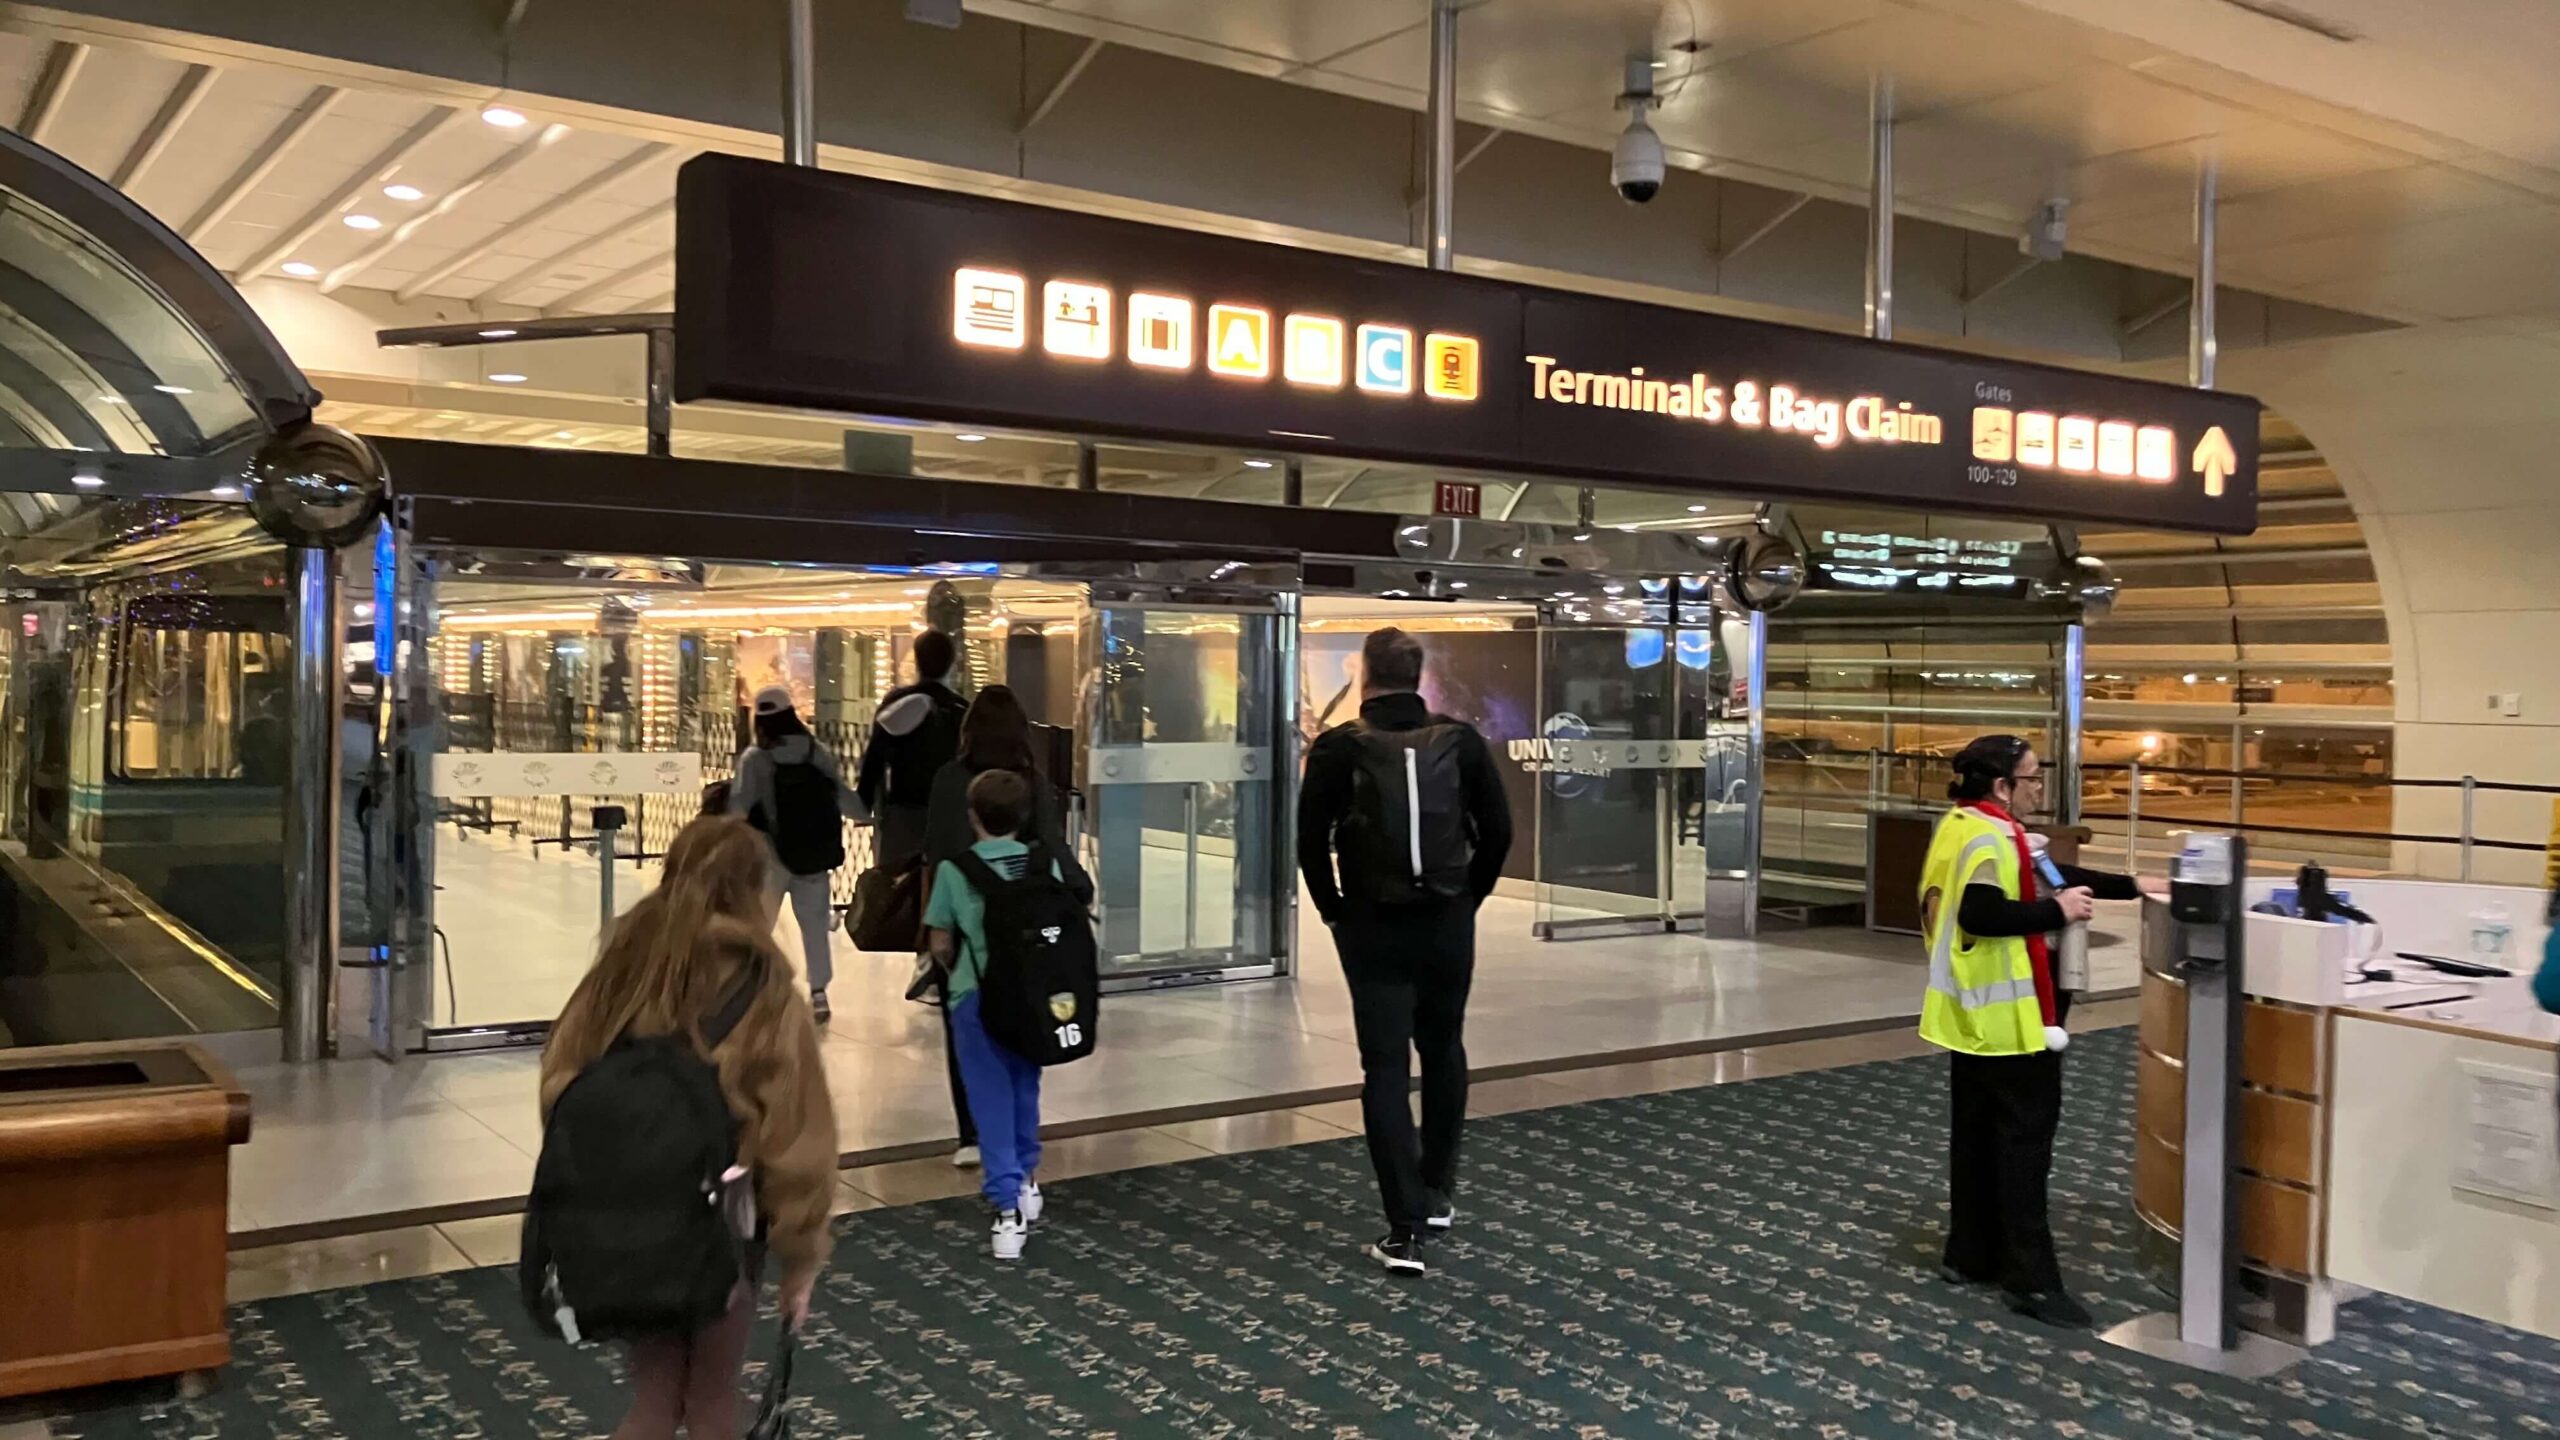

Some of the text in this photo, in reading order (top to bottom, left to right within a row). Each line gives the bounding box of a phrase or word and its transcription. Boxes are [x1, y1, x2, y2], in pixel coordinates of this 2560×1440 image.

[1219, 318, 1260, 362] A
[1368, 337, 1402, 382] C
[1525, 355, 1942, 446] Terminals & Bag Claim
[1975, 381, 2012, 402] Gates
[1967, 465, 2017, 486] 100-129
[1442, 484, 1475, 514] EXIT
[1053, 1023, 1083, 1049] 16
